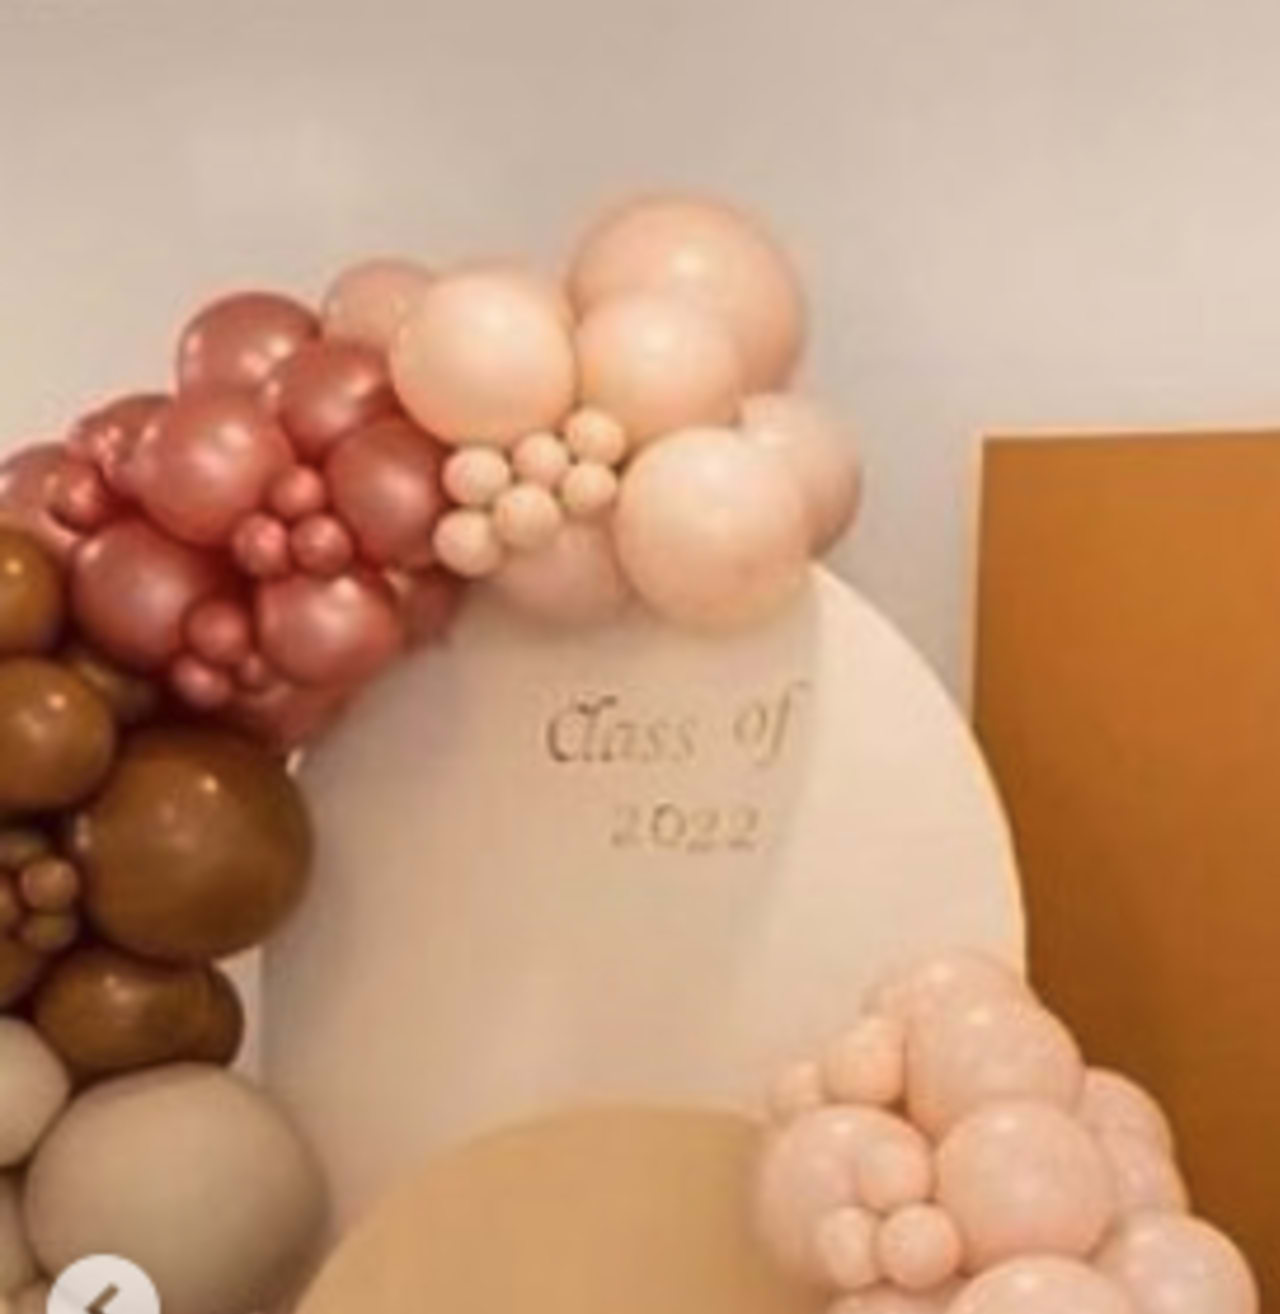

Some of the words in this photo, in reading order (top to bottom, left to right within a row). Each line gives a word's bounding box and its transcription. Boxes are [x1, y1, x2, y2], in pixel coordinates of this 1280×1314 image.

[546, 694, 696, 764] Class
[733, 678, 813, 770] of
[610, 802, 760, 854] 2022
